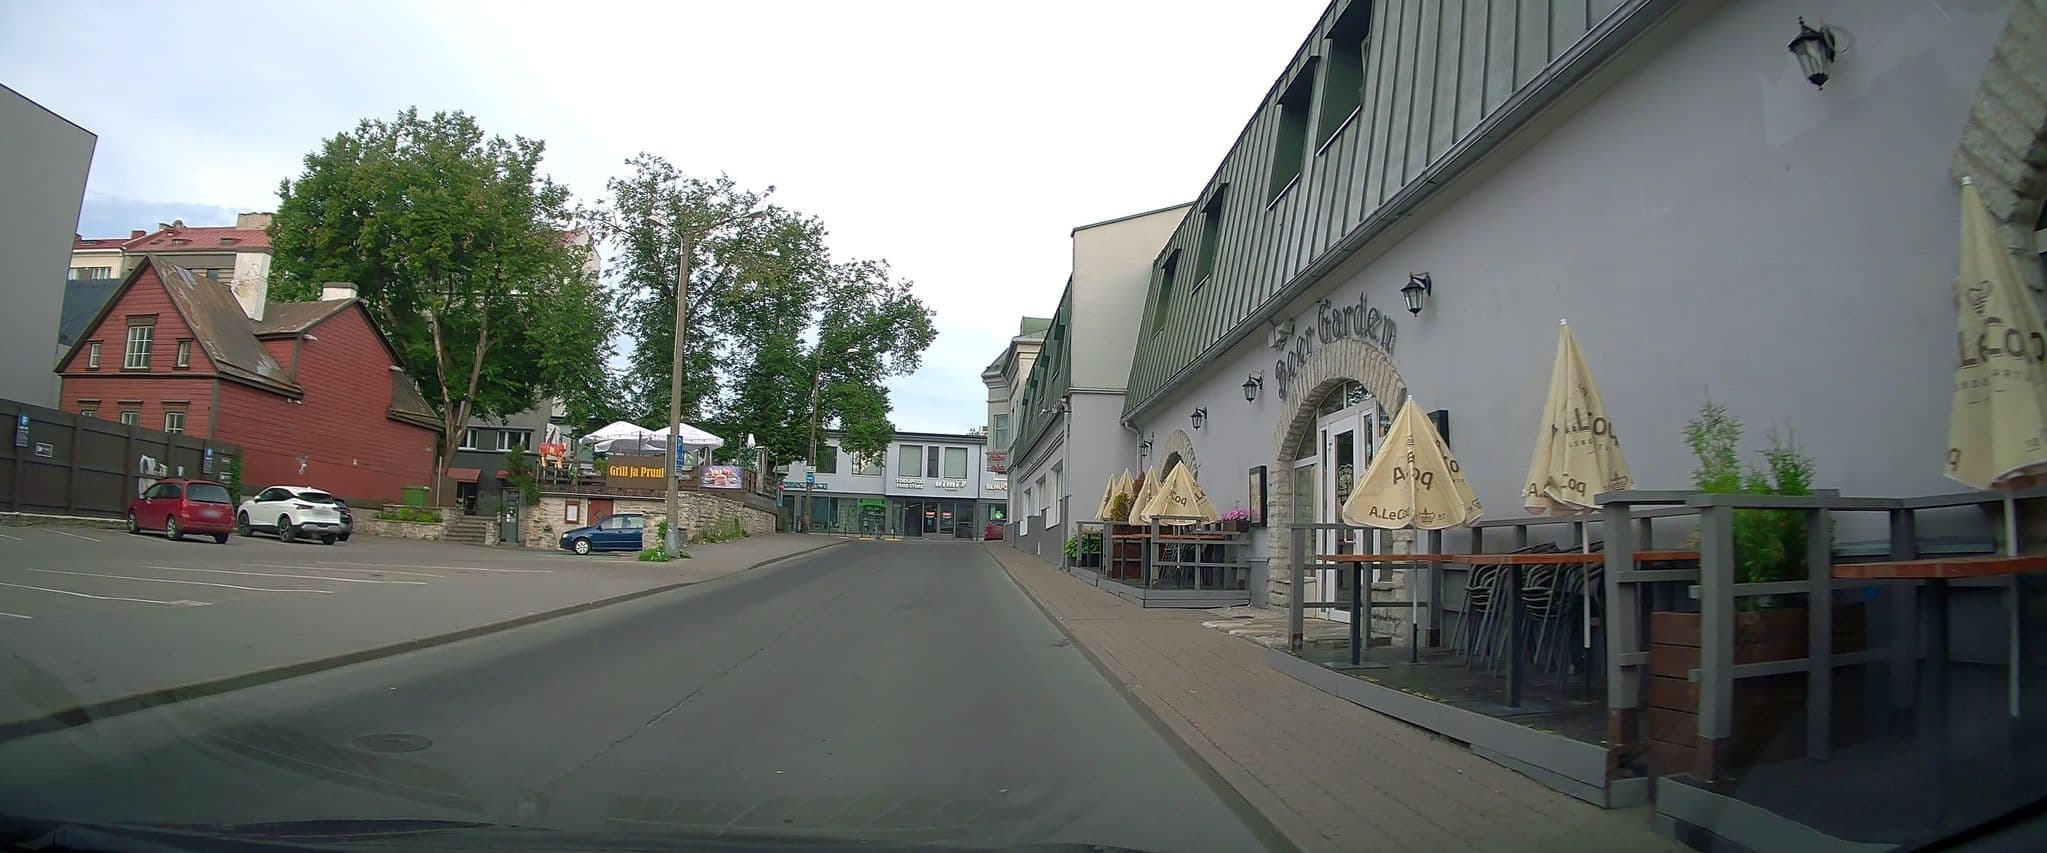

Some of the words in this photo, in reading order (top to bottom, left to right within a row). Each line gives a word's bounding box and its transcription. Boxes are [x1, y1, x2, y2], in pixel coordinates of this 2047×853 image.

[1275, 326, 1315, 400] Beer
[1317, 291, 1397, 354] Garden
[609, 465, 628, 477] Grill
[640, 466, 665, 478] Pruul
